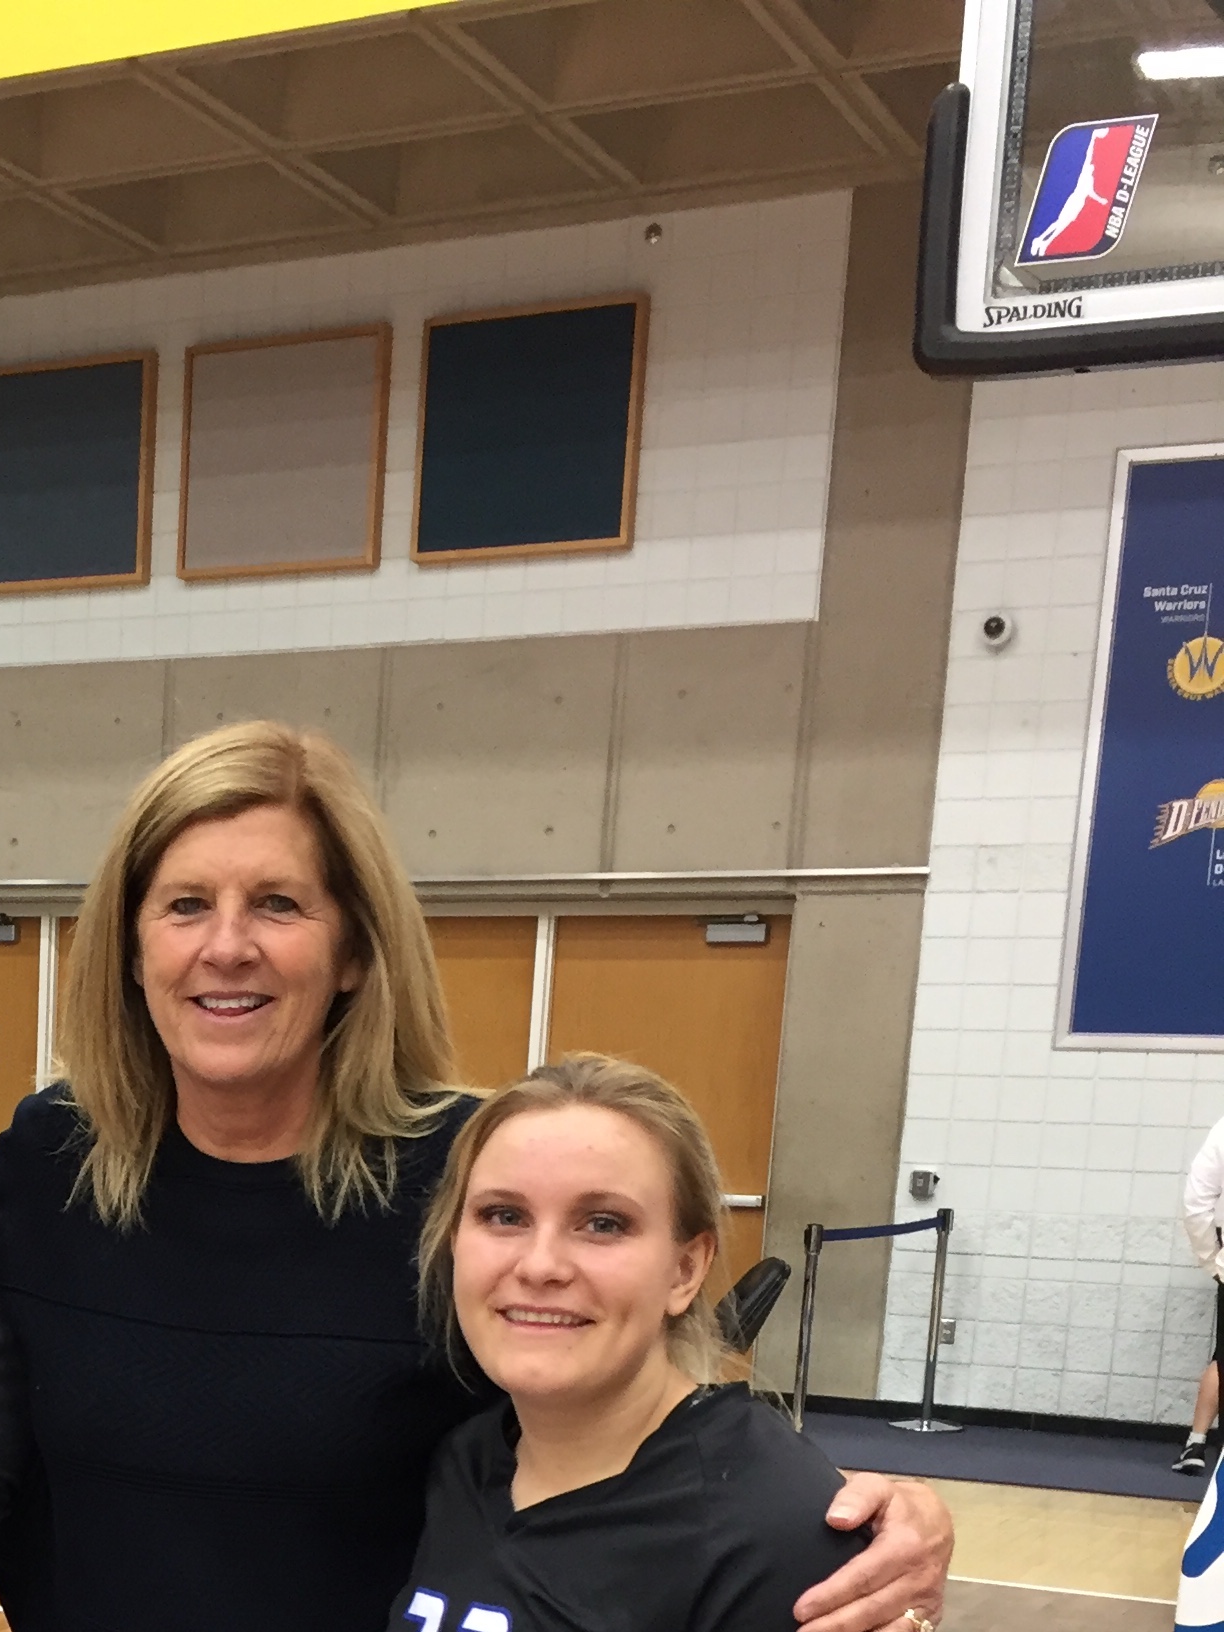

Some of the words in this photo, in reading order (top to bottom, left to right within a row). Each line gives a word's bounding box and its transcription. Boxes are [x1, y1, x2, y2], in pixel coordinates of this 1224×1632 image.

[1104, 207, 1126, 239] NBA
[1116, 124, 1150, 204] D-LEAGUE
[983, 296, 1084, 328] SPALDING
[1143, 585, 1178, 598] Santa
[1180, 584, 1208, 596] Cruz
[1154, 599, 1206, 612] Warriors
